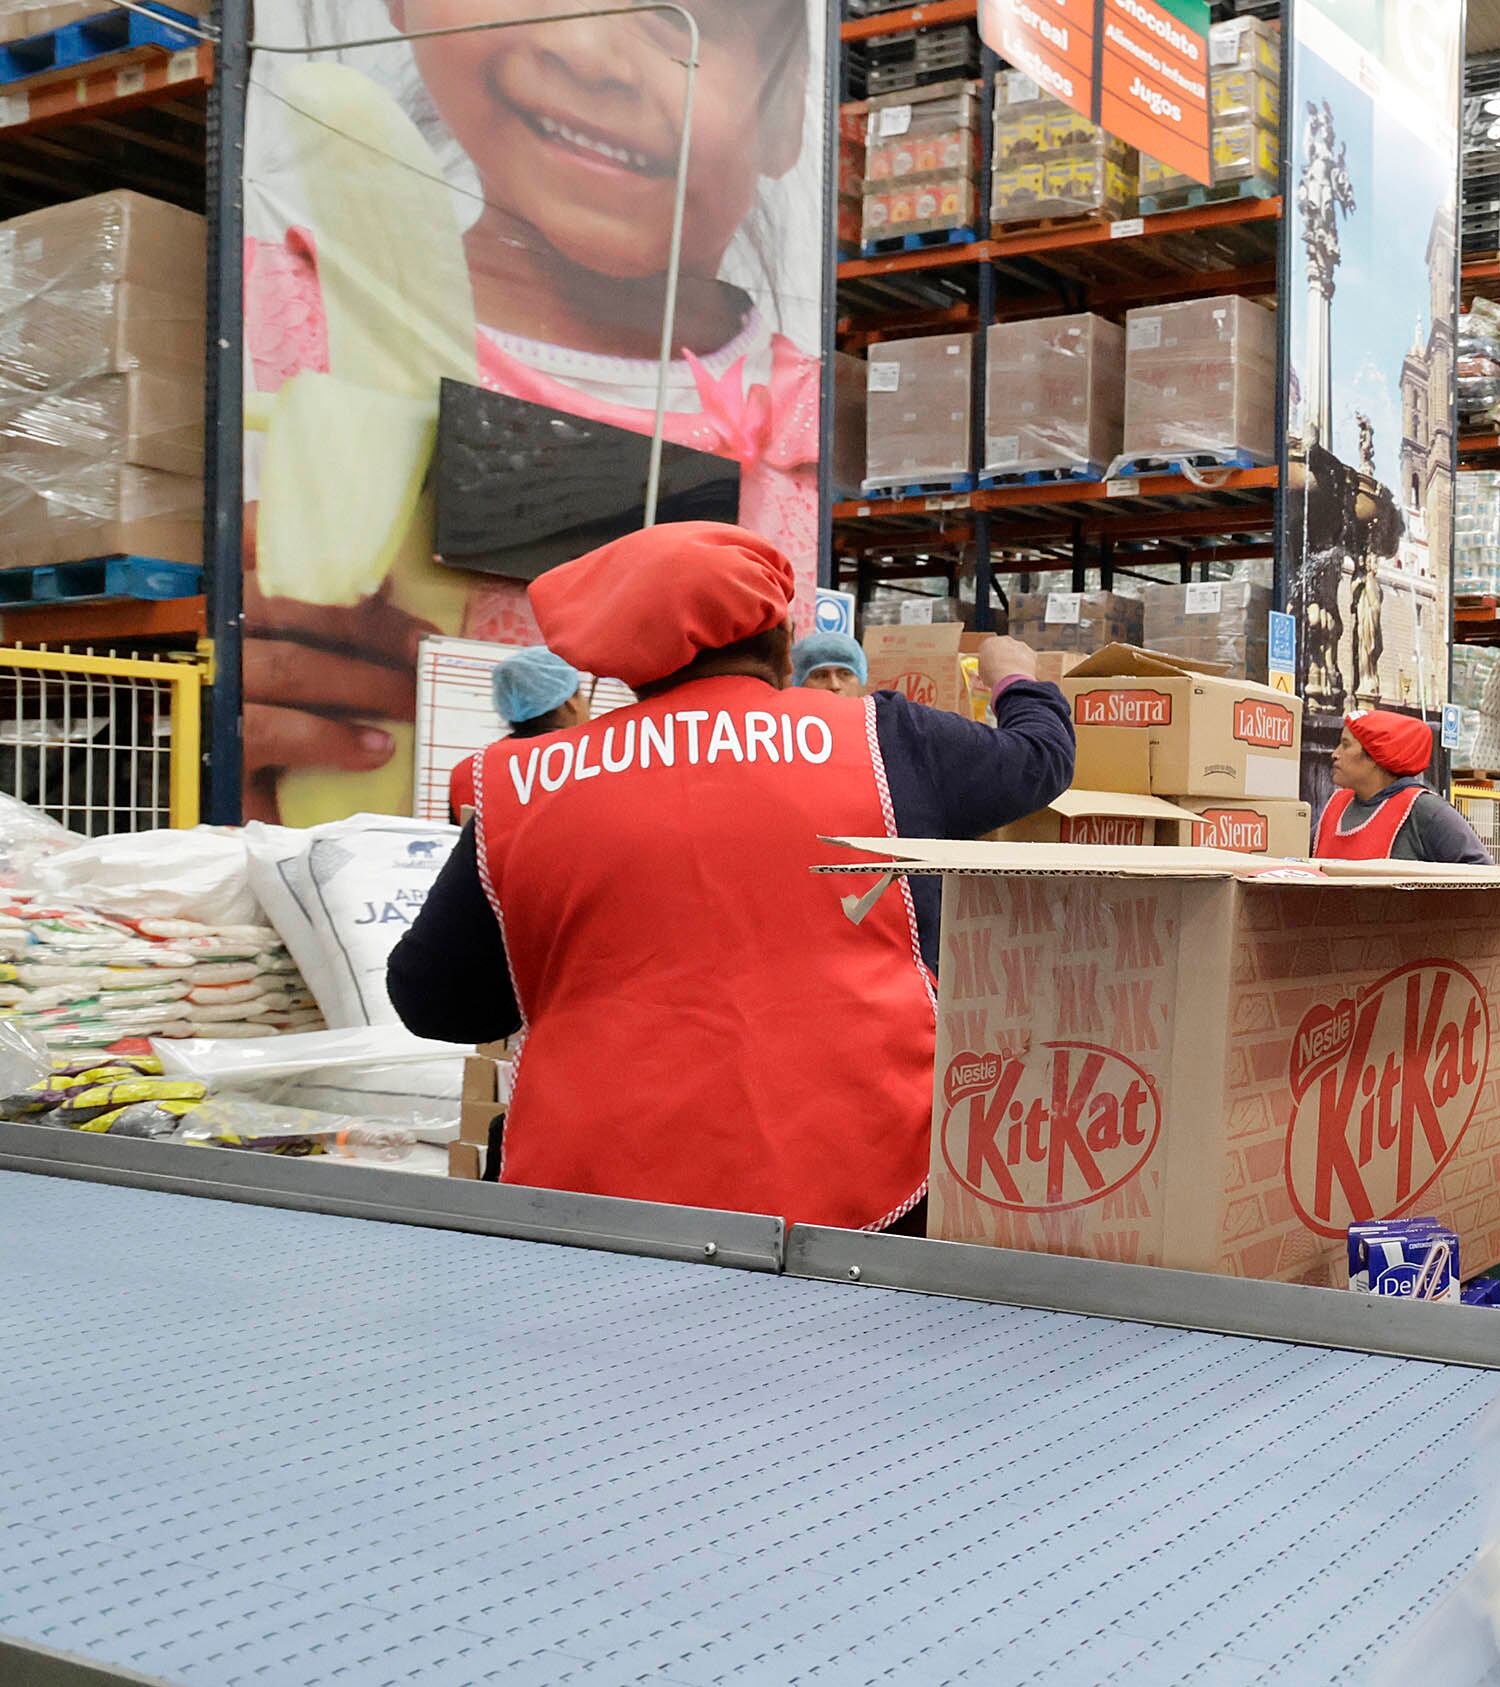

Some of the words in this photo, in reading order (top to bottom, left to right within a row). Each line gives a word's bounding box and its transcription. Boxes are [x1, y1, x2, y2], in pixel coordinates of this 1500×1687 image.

[1129, 77, 1182, 122] Jugos
[1084, 699, 1105, 722] La
[1107, 694, 1164, 722] Sierra
[1239, 709, 1254, 737] La
[1255, 710, 1289, 742] Sierra
[509, 710, 833, 805] VOLUNTARIO
[1200, 822, 1217, 848] La
[1220, 815, 1263, 848] Sierra
[396, 889, 429, 901] AR
[354, 901, 424, 925] JA
[1299, 1011, 1350, 1064] Nestlé
[951, 1060, 997, 1087] Nestlé
[1314, 971, 1481, 1223] KitKat
[966, 1050, 1147, 1204] KitKat
